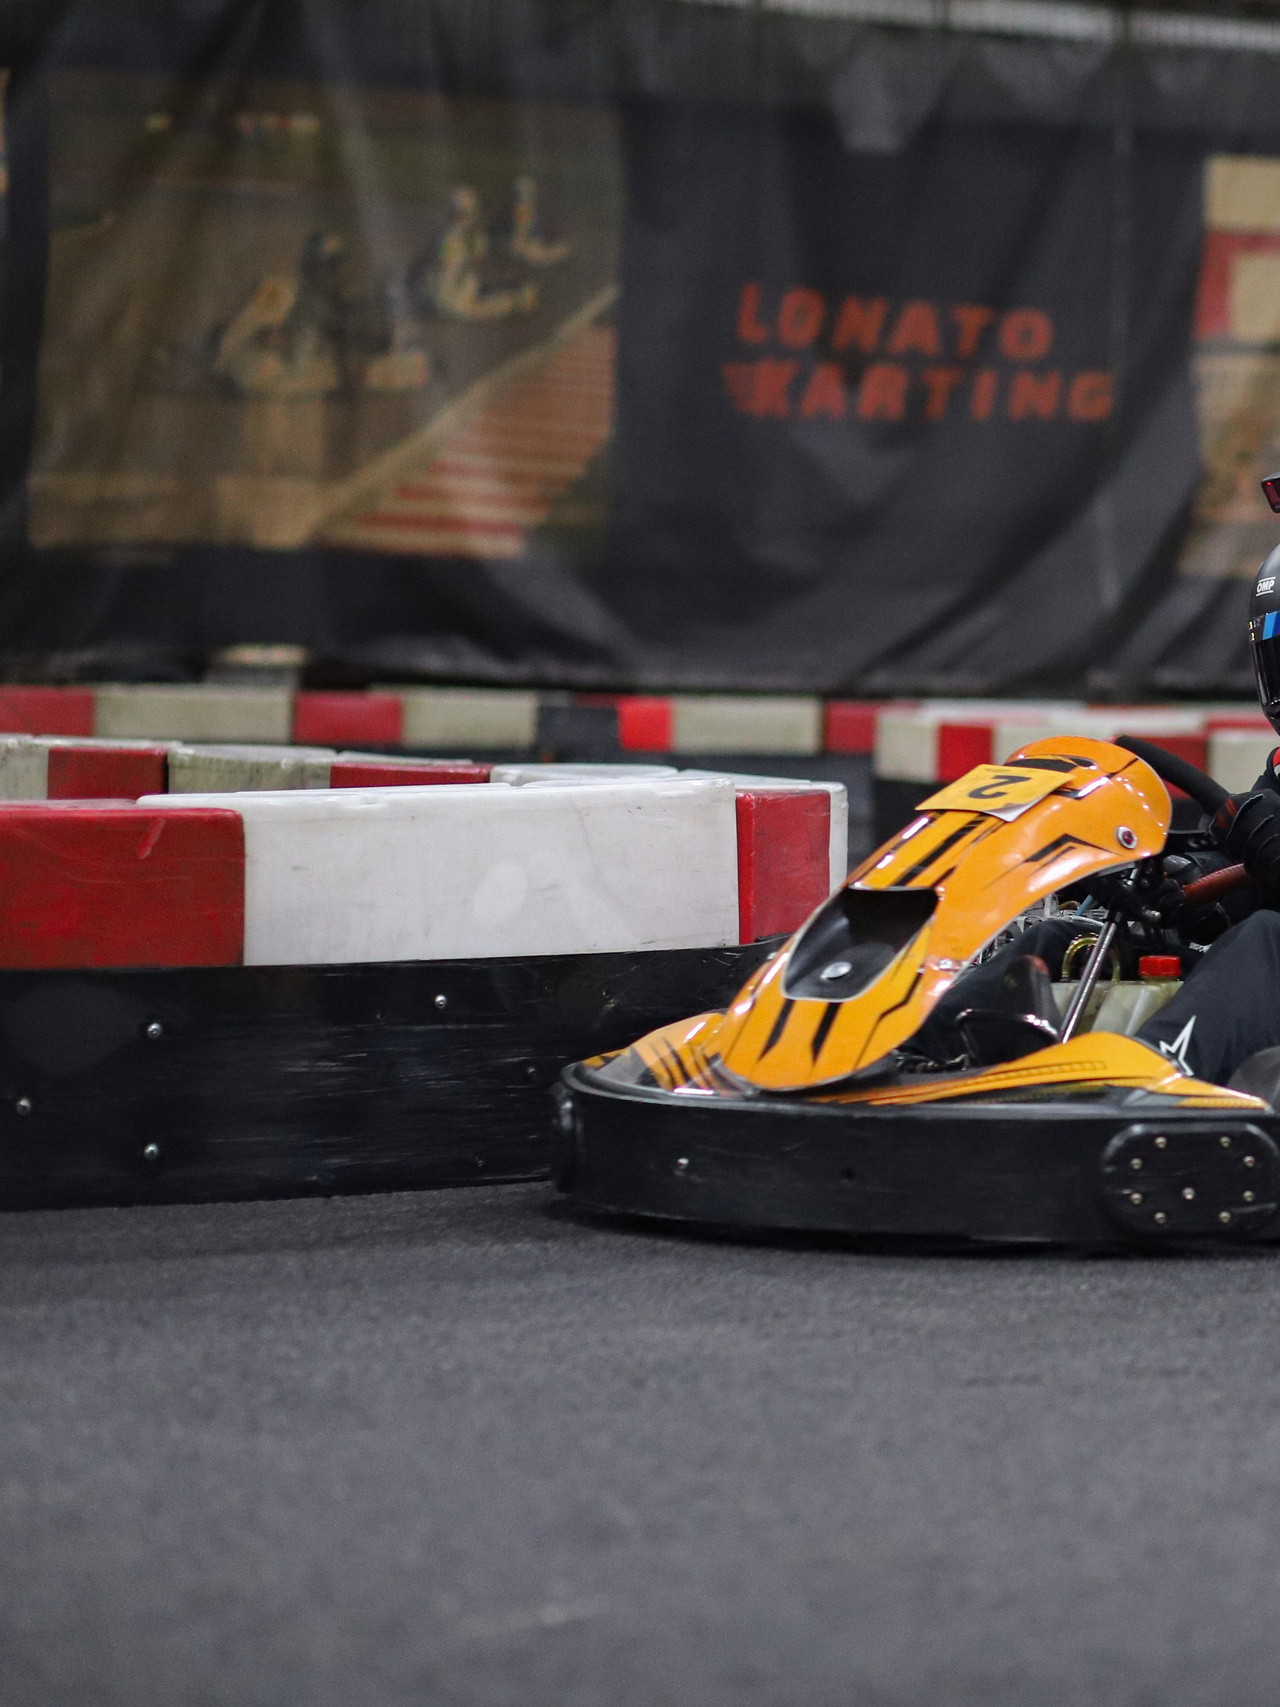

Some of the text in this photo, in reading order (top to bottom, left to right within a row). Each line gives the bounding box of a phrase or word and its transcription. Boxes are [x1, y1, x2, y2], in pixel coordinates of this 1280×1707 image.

[735, 282, 1054, 361] LONATO
[726, 358, 1114, 422] KARTING
[1256, 579, 1275, 593] OMP
